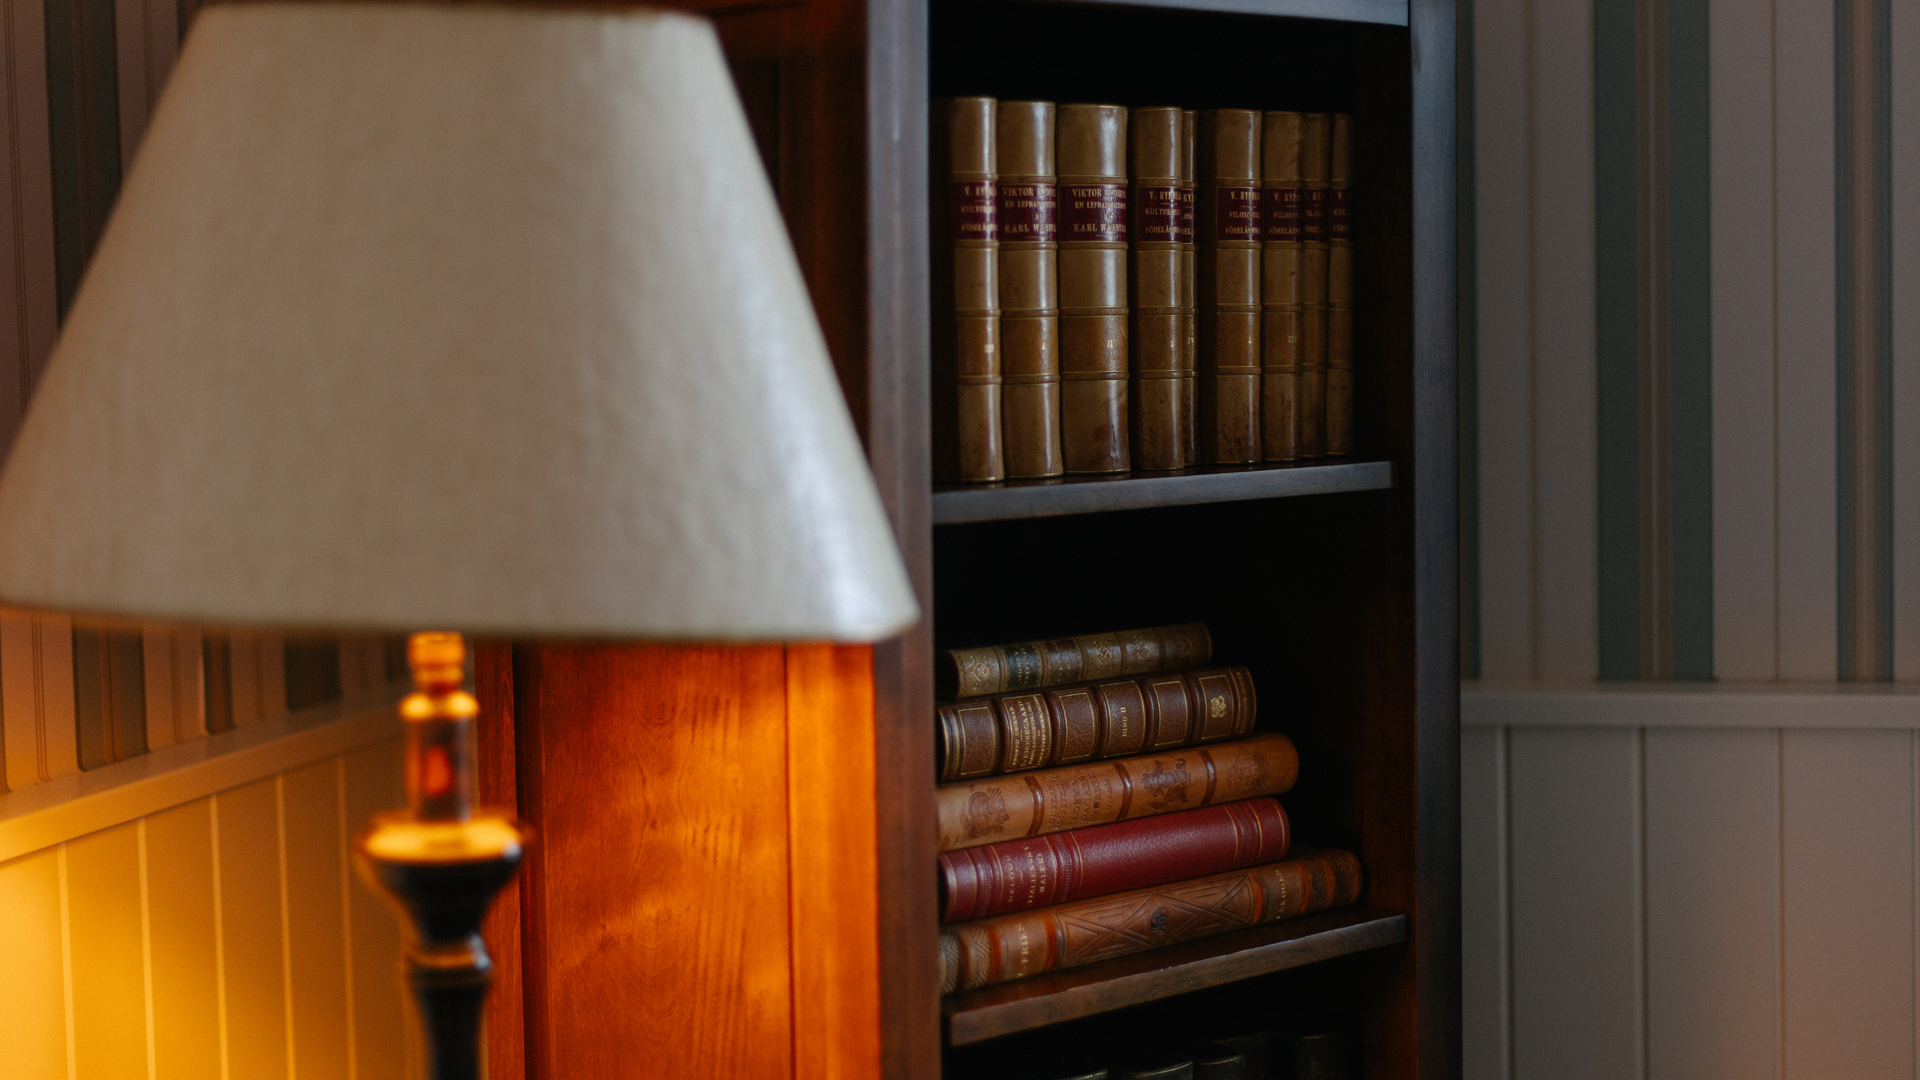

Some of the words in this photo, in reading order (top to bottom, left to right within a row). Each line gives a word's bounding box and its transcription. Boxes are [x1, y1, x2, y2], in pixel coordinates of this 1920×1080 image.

[1002, 187, 1034, 197] VIKTOR
[1072, 188, 1102, 198] VIKTOR
[1005, 200, 1015, 208] EN
[1074, 201, 1084, 209] EN
[1004, 223, 1030, 234] KARL
[1073, 223, 1098, 232] KARL
[1018, 700, 1031, 759] KIERKEGAARD
